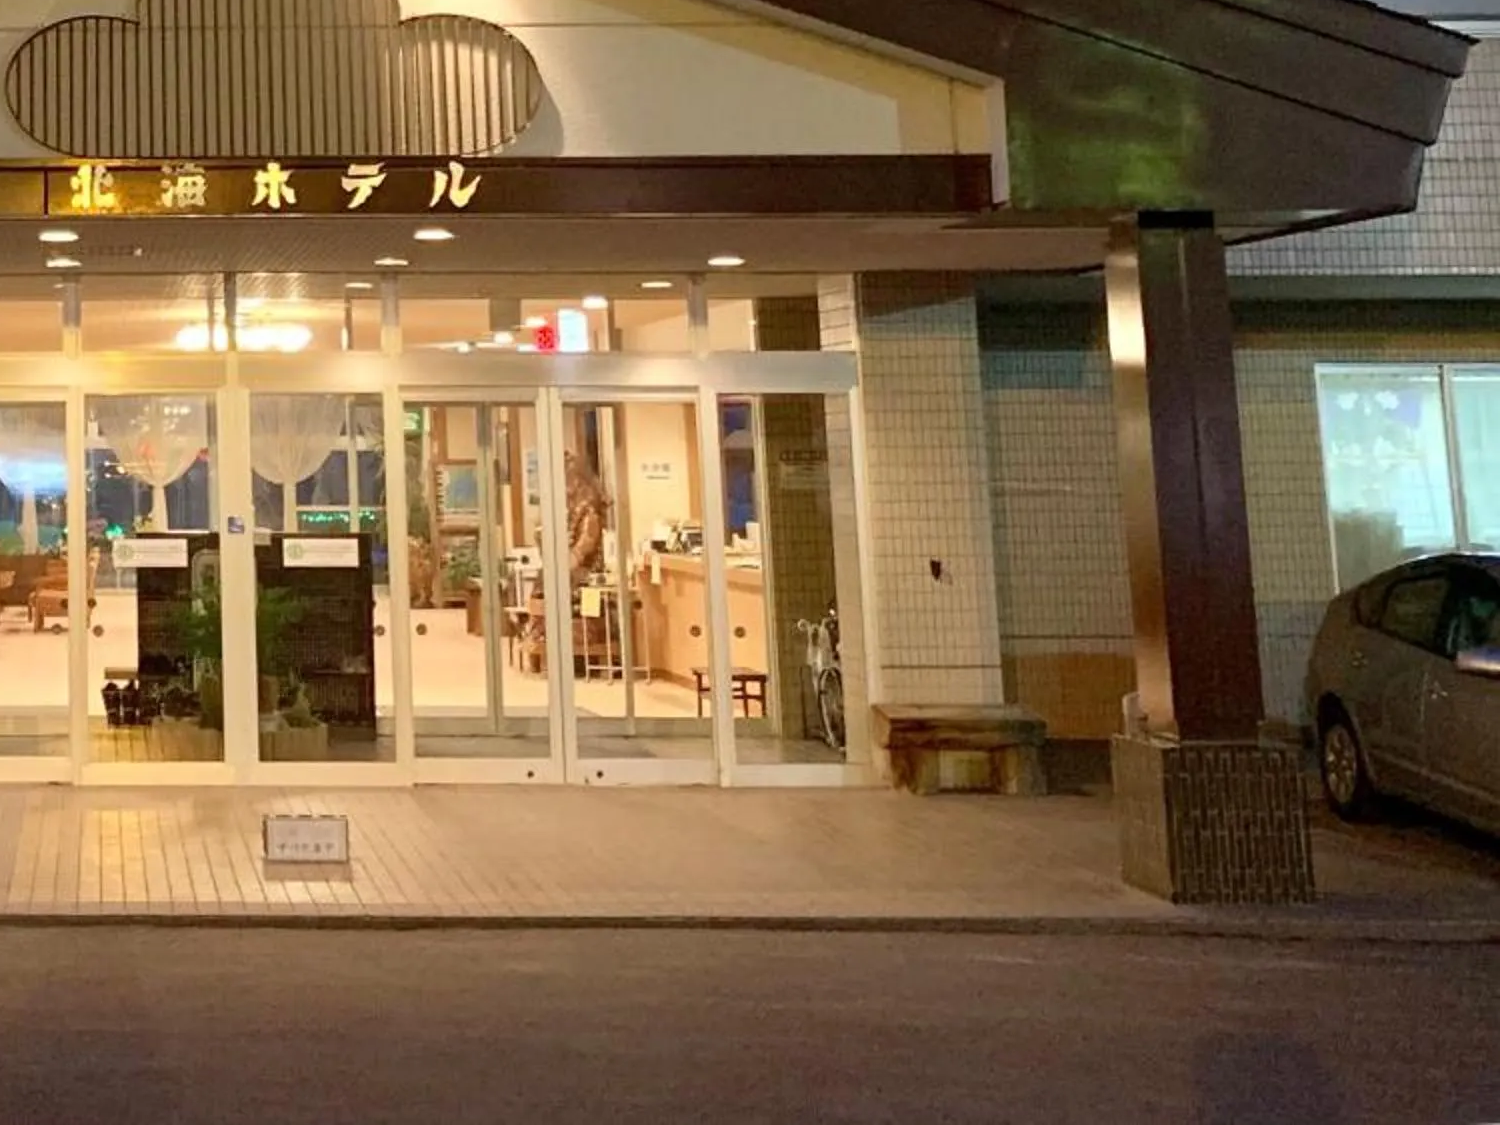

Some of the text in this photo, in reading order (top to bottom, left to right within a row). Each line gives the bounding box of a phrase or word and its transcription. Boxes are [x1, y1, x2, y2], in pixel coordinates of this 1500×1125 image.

[69, 161, 481, 209] 北海ホテル
